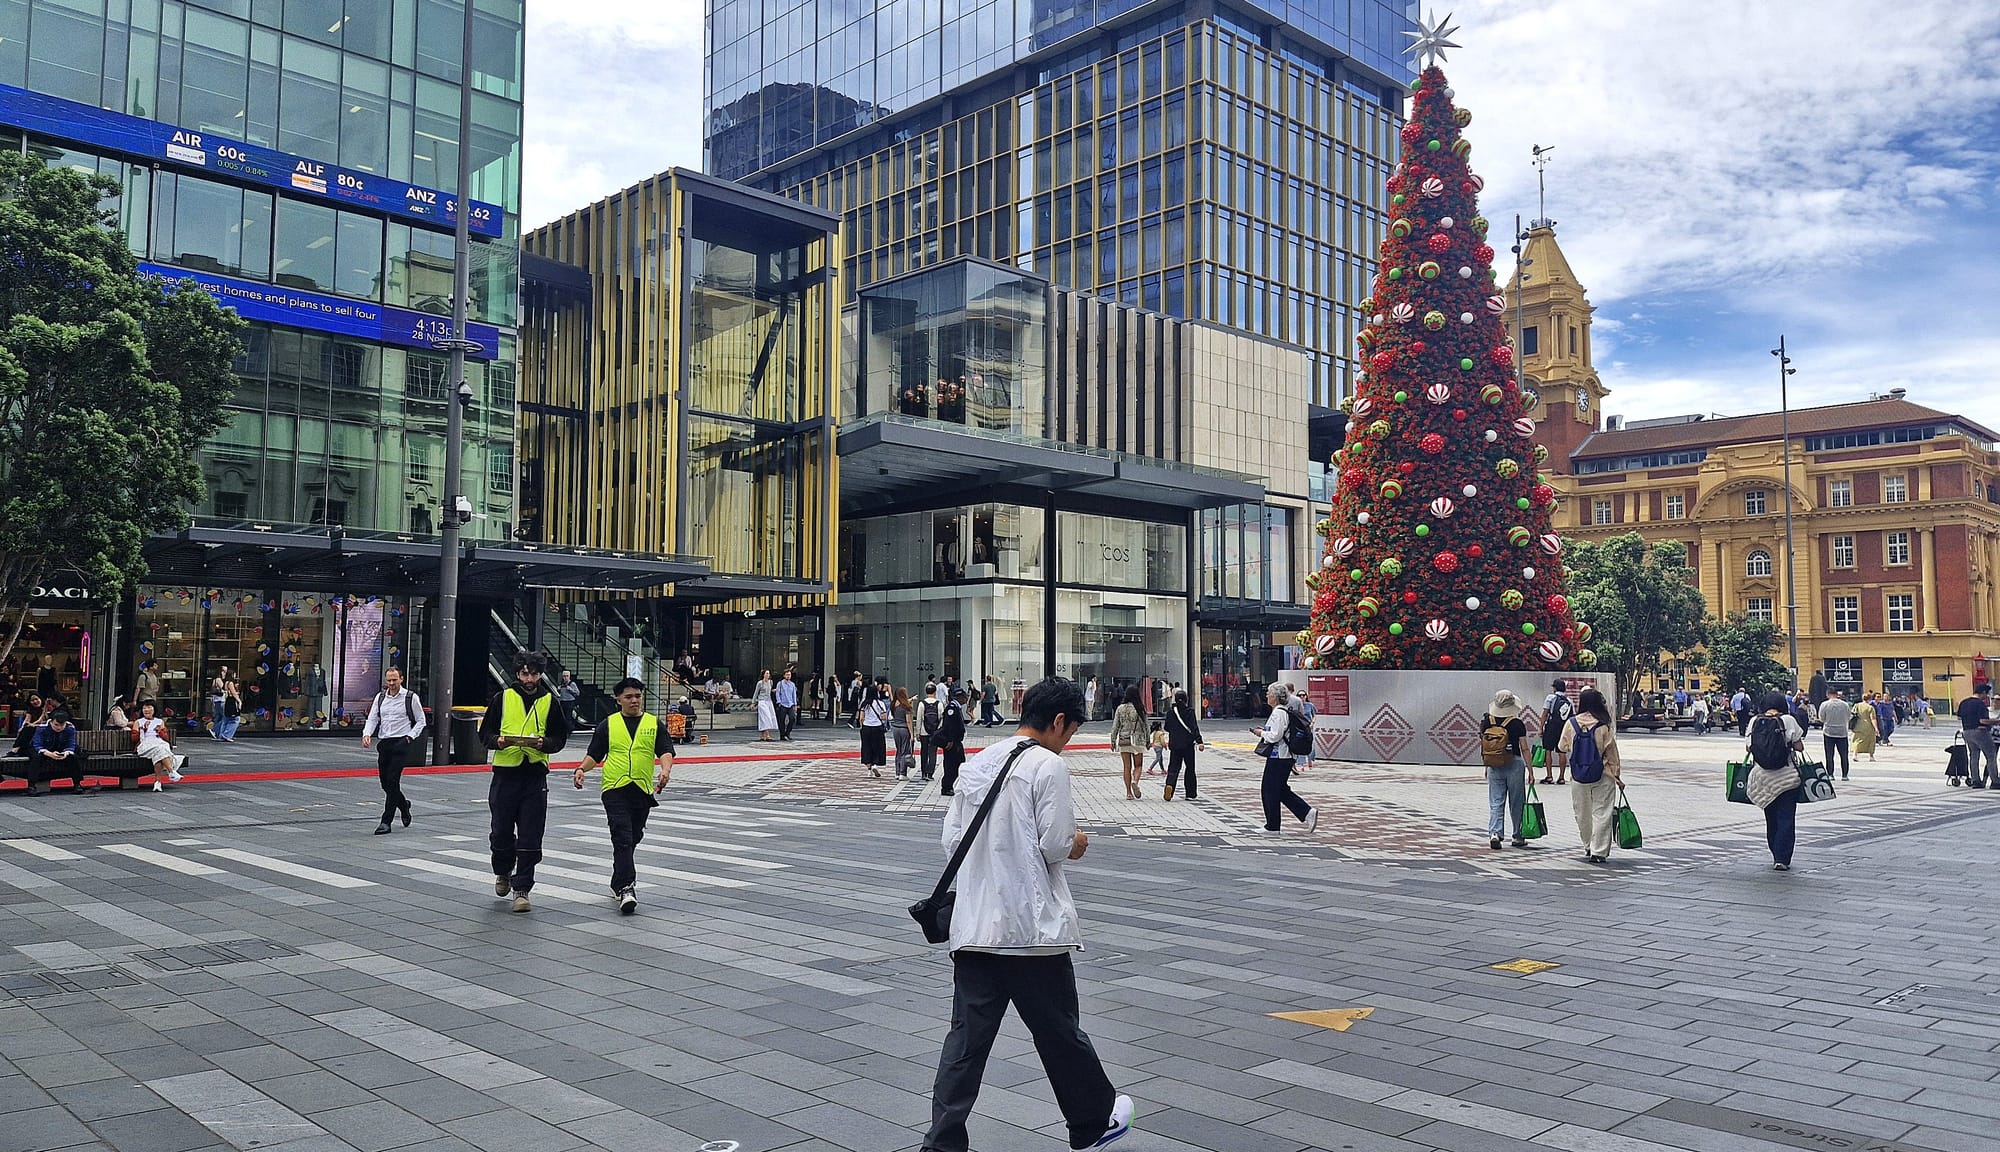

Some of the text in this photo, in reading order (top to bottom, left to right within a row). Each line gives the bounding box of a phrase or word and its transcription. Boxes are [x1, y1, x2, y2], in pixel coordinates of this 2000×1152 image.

[172, 131, 202, 148] AIR
[217, 146, 247, 162] 60¢
[295, 160, 325, 176] ALF
[337, 174, 364, 190] 80¢
[405, 187, 437, 204] ANZ
[446, 200, 490, 220] $.62
[223, 284, 262, 300] homes
[265, 294, 286, 304] and
[289, 297, 318, 310] plans
[321, 303, 332, 312] to
[335, 306, 352, 316] sell
[355, 307, 376, 320] four
[411, 330, 424, 340] 28
[416, 319, 453, 339] 4:13p
[1102, 546, 1130, 563] COS
[31, 586, 101, 599] OAC
[1056, 664, 1066, 672] OS
[1750, 1121, 1854, 1148] Street
